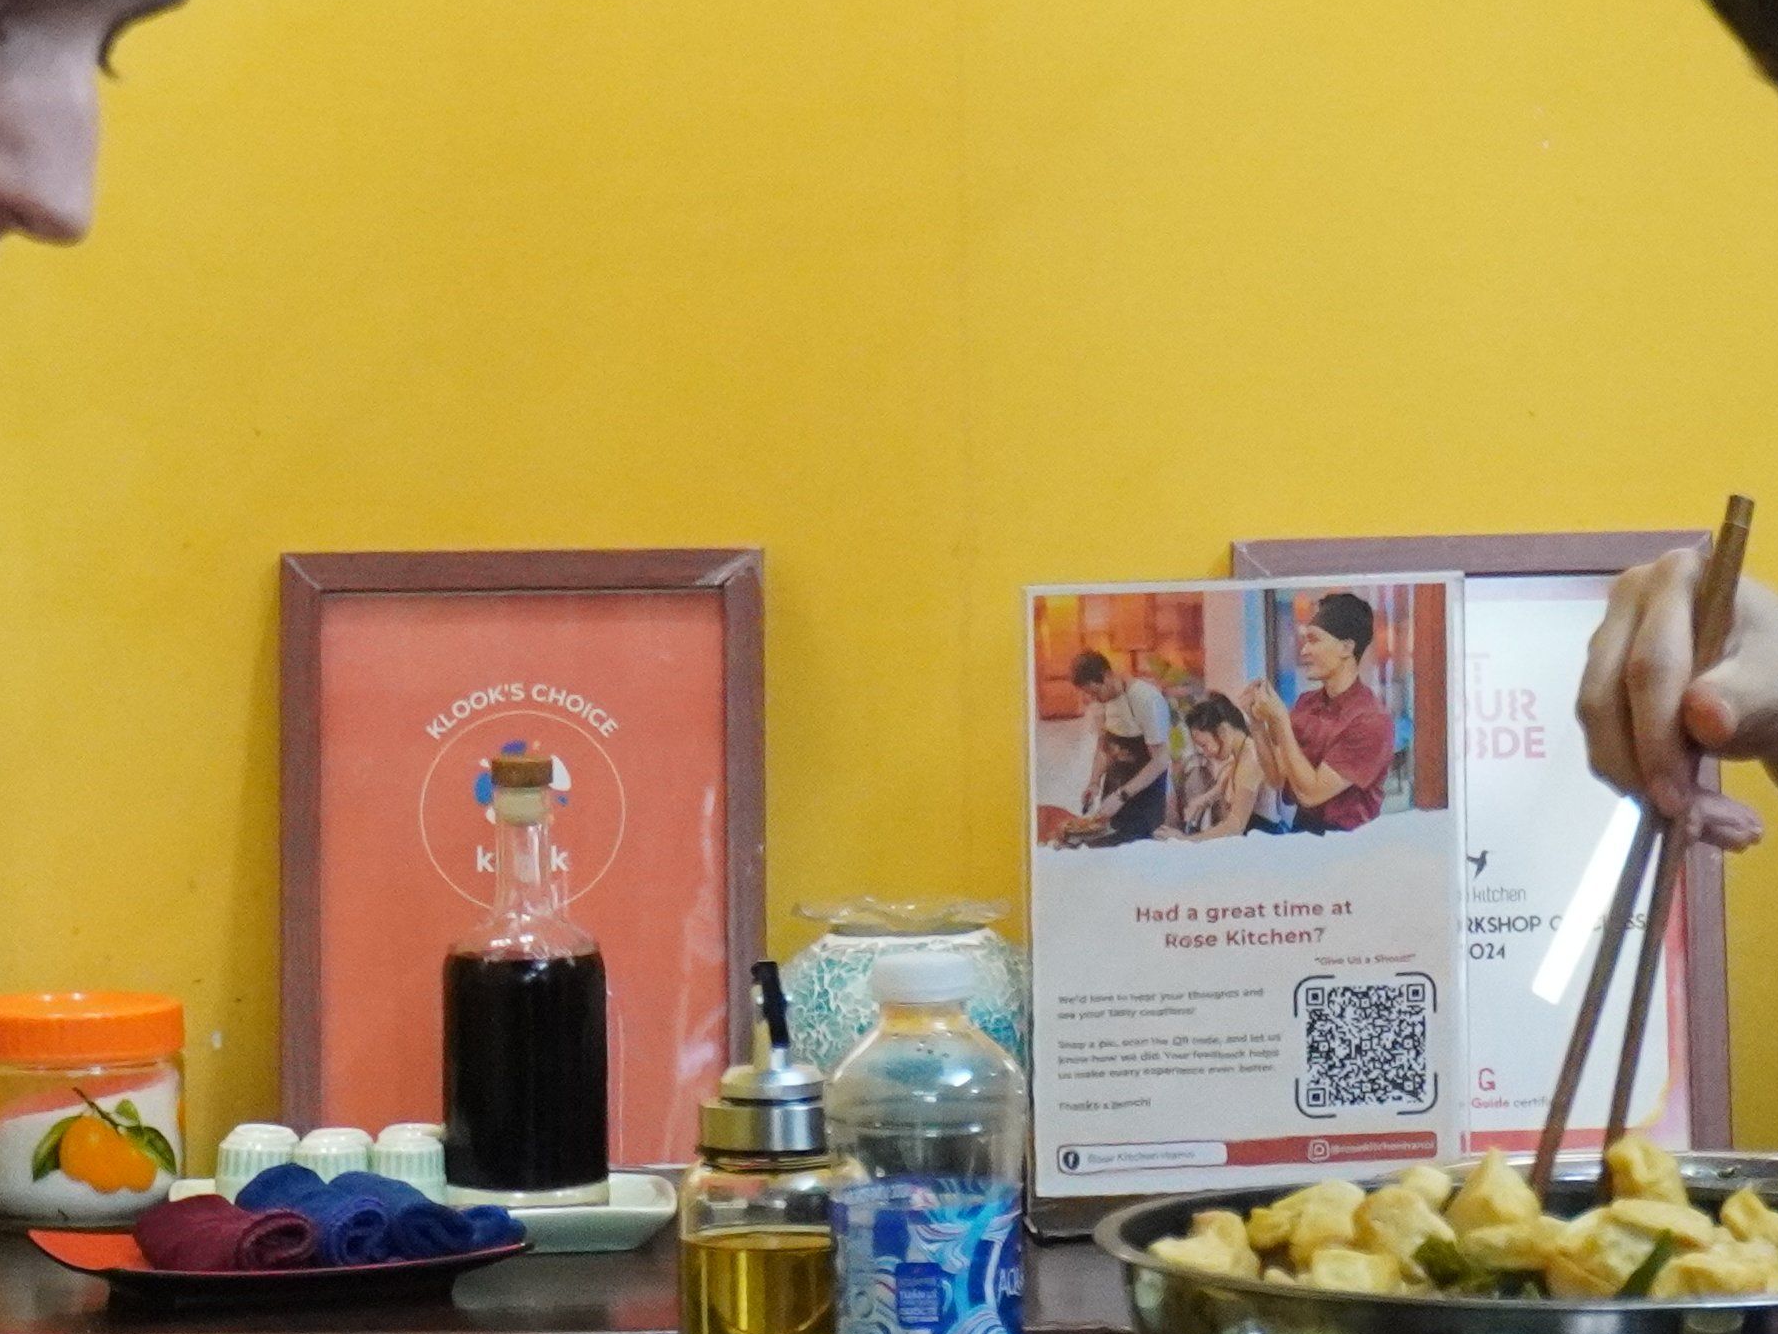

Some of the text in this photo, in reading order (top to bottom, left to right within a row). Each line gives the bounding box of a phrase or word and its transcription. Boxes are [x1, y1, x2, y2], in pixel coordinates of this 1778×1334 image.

[425, 681, 619, 740] KLOOK'S CHOICE
[1135, 900, 1353, 924] Had a great time at
[1164, 926, 1327, 949] Rose Kitchen?
